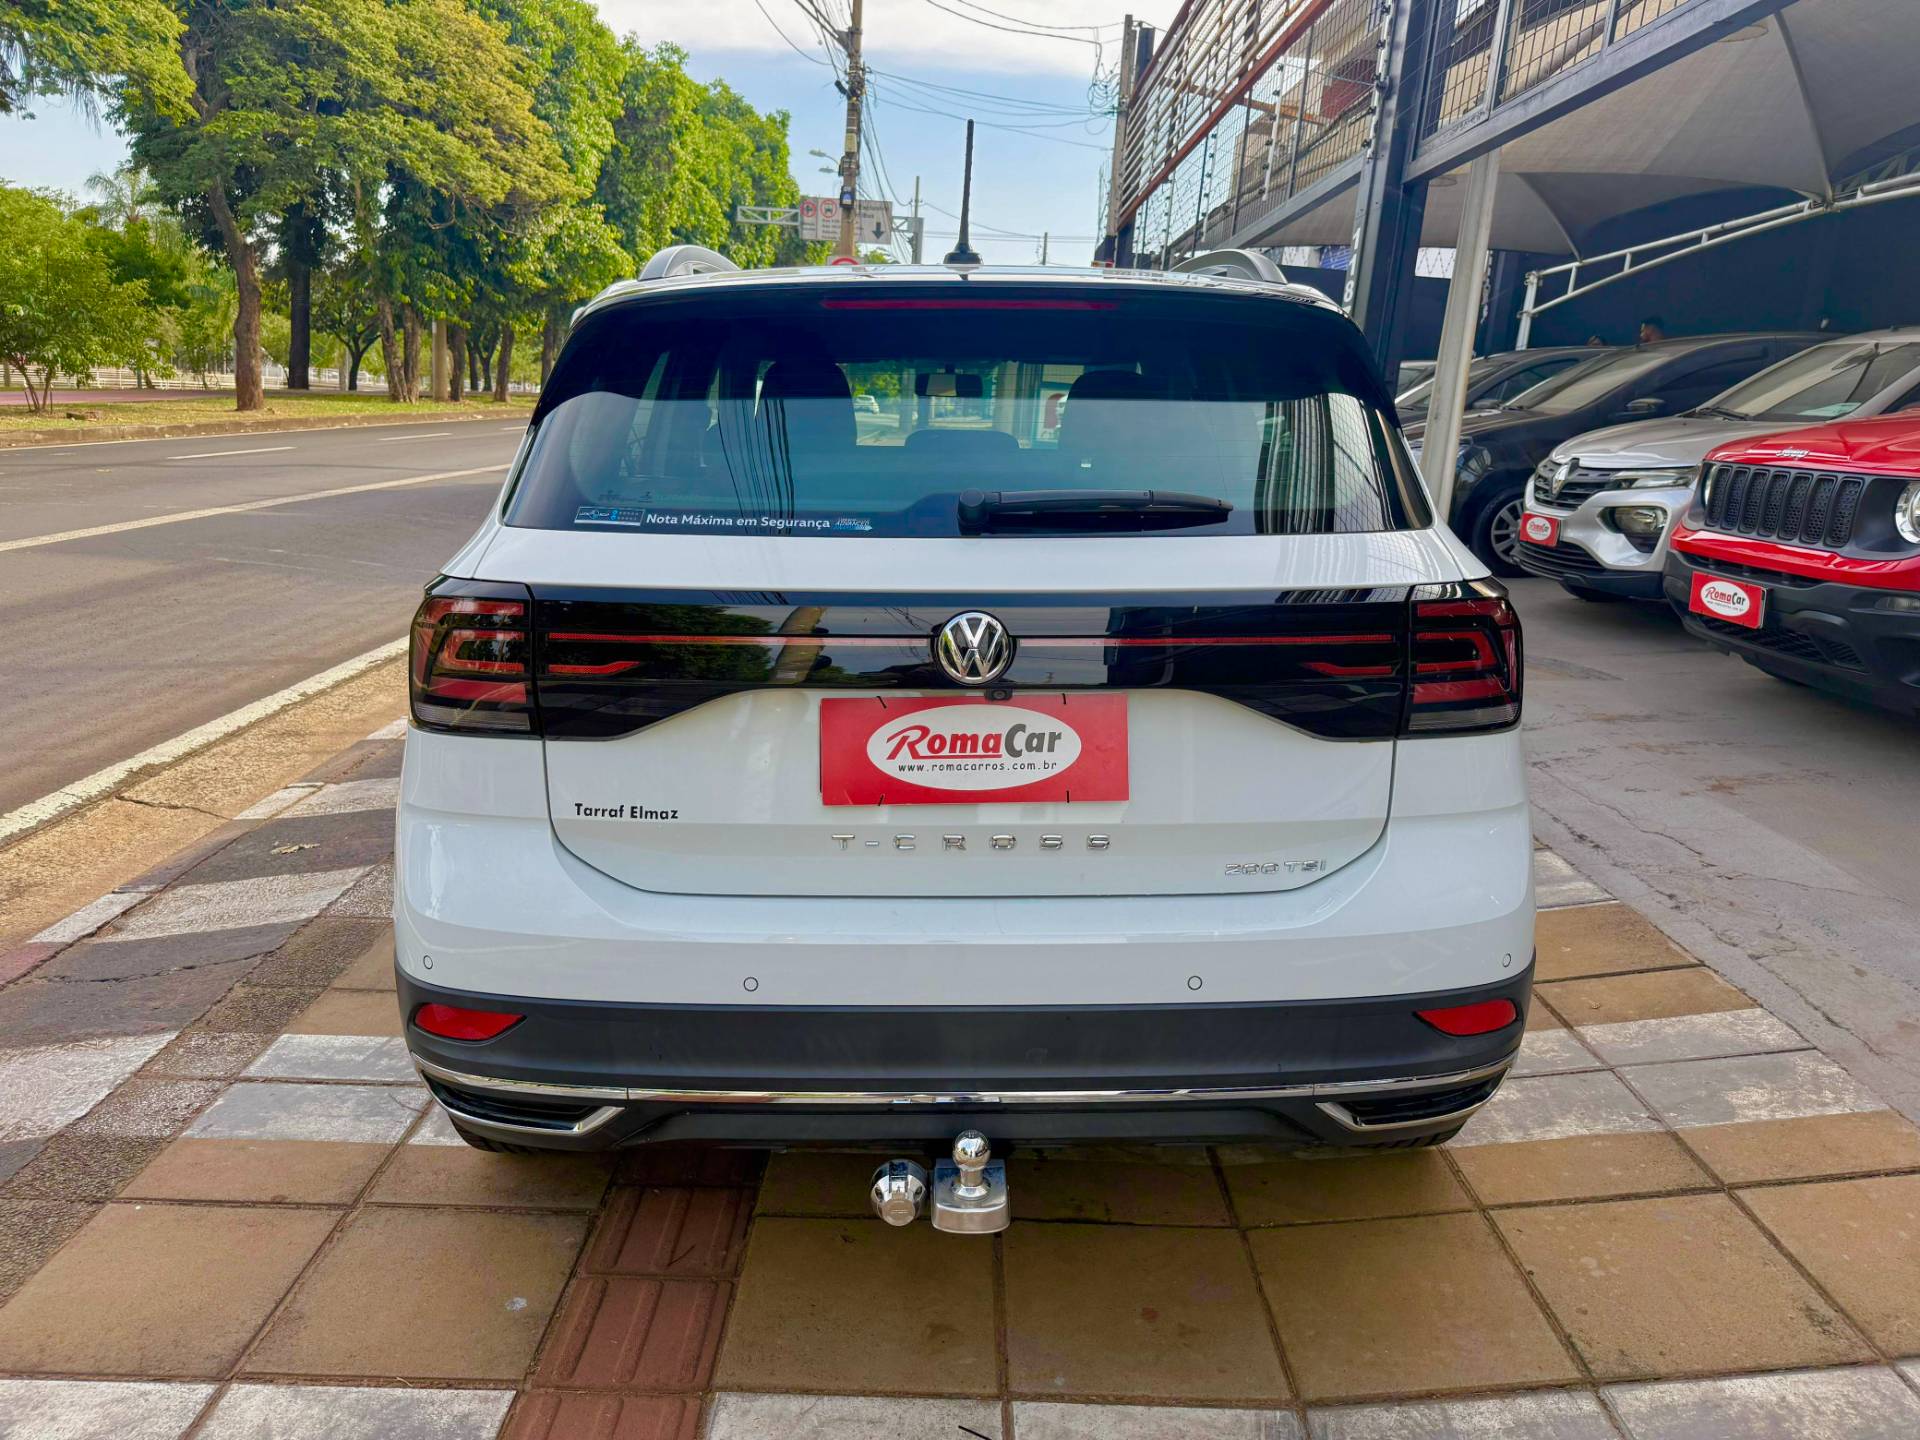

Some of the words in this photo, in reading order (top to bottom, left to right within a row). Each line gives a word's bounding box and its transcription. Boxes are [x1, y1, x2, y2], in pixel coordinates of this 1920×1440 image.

[646, 513, 678, 524] Nota
[681, 514, 733, 526] Máxima
[736, 518, 757, 526] em
[761, 516, 830, 530] Segurança
[1705, 586, 1746, 605] RomaCar
[886, 723, 1062, 760] RomaCar
[898, 760, 1057, 772] www.romacarros.com.br
[574, 803, 625, 818] Tarraf
[630, 805, 679, 820] Elmaz
